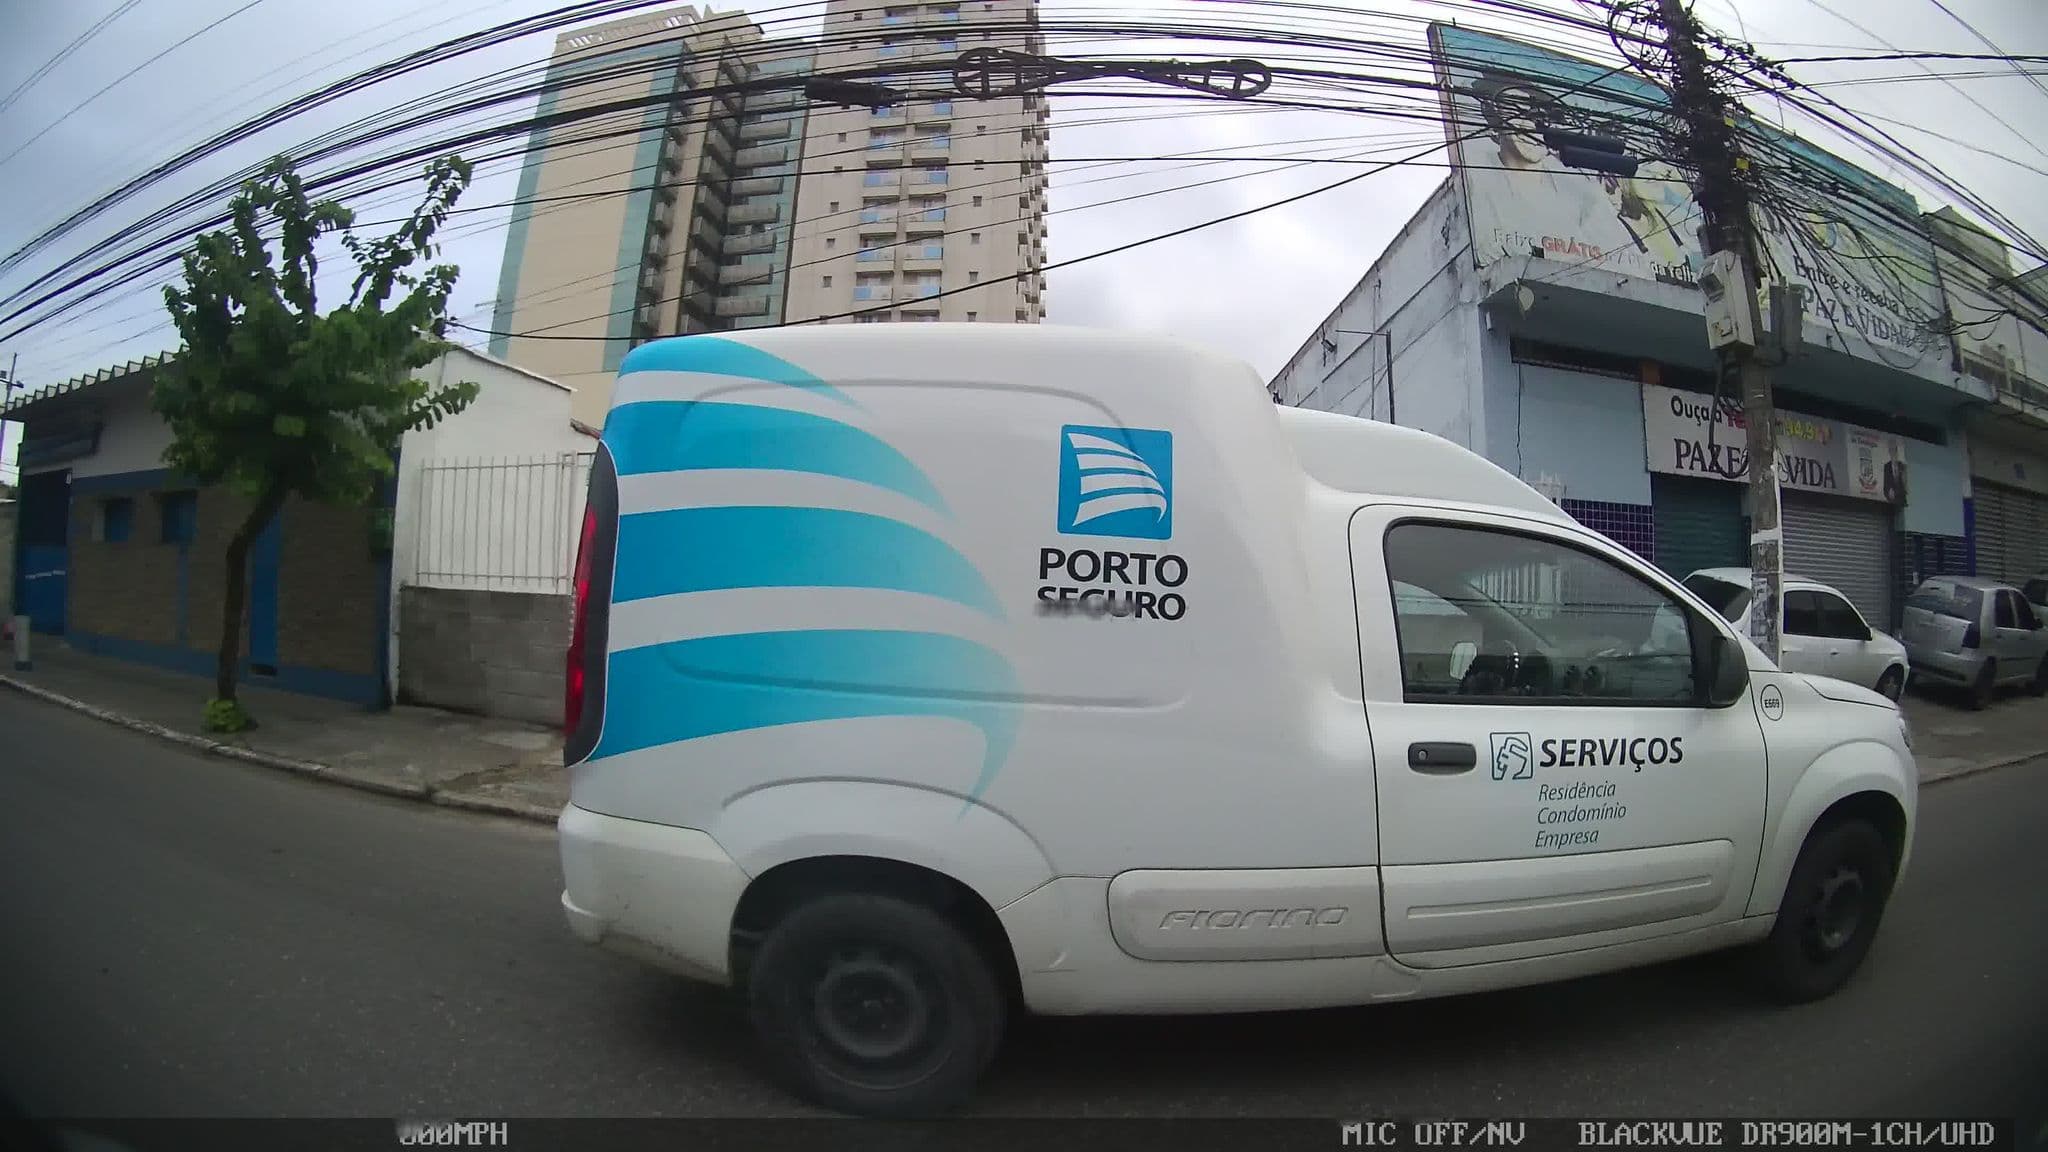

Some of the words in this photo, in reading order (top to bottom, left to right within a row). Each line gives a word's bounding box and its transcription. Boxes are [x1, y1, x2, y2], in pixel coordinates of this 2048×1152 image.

[1671, 395, 1709, 427] Ouça
[1785, 455, 1836, 488] VIDA
[1039, 548, 1188, 587] PORTO
[1539, 737, 1683, 773] SERVIÇOS
[1538, 780, 1616, 802] Residência
[1537, 802, 1627, 825] Condomínio
[1535, 830, 1599, 849] Empresa
